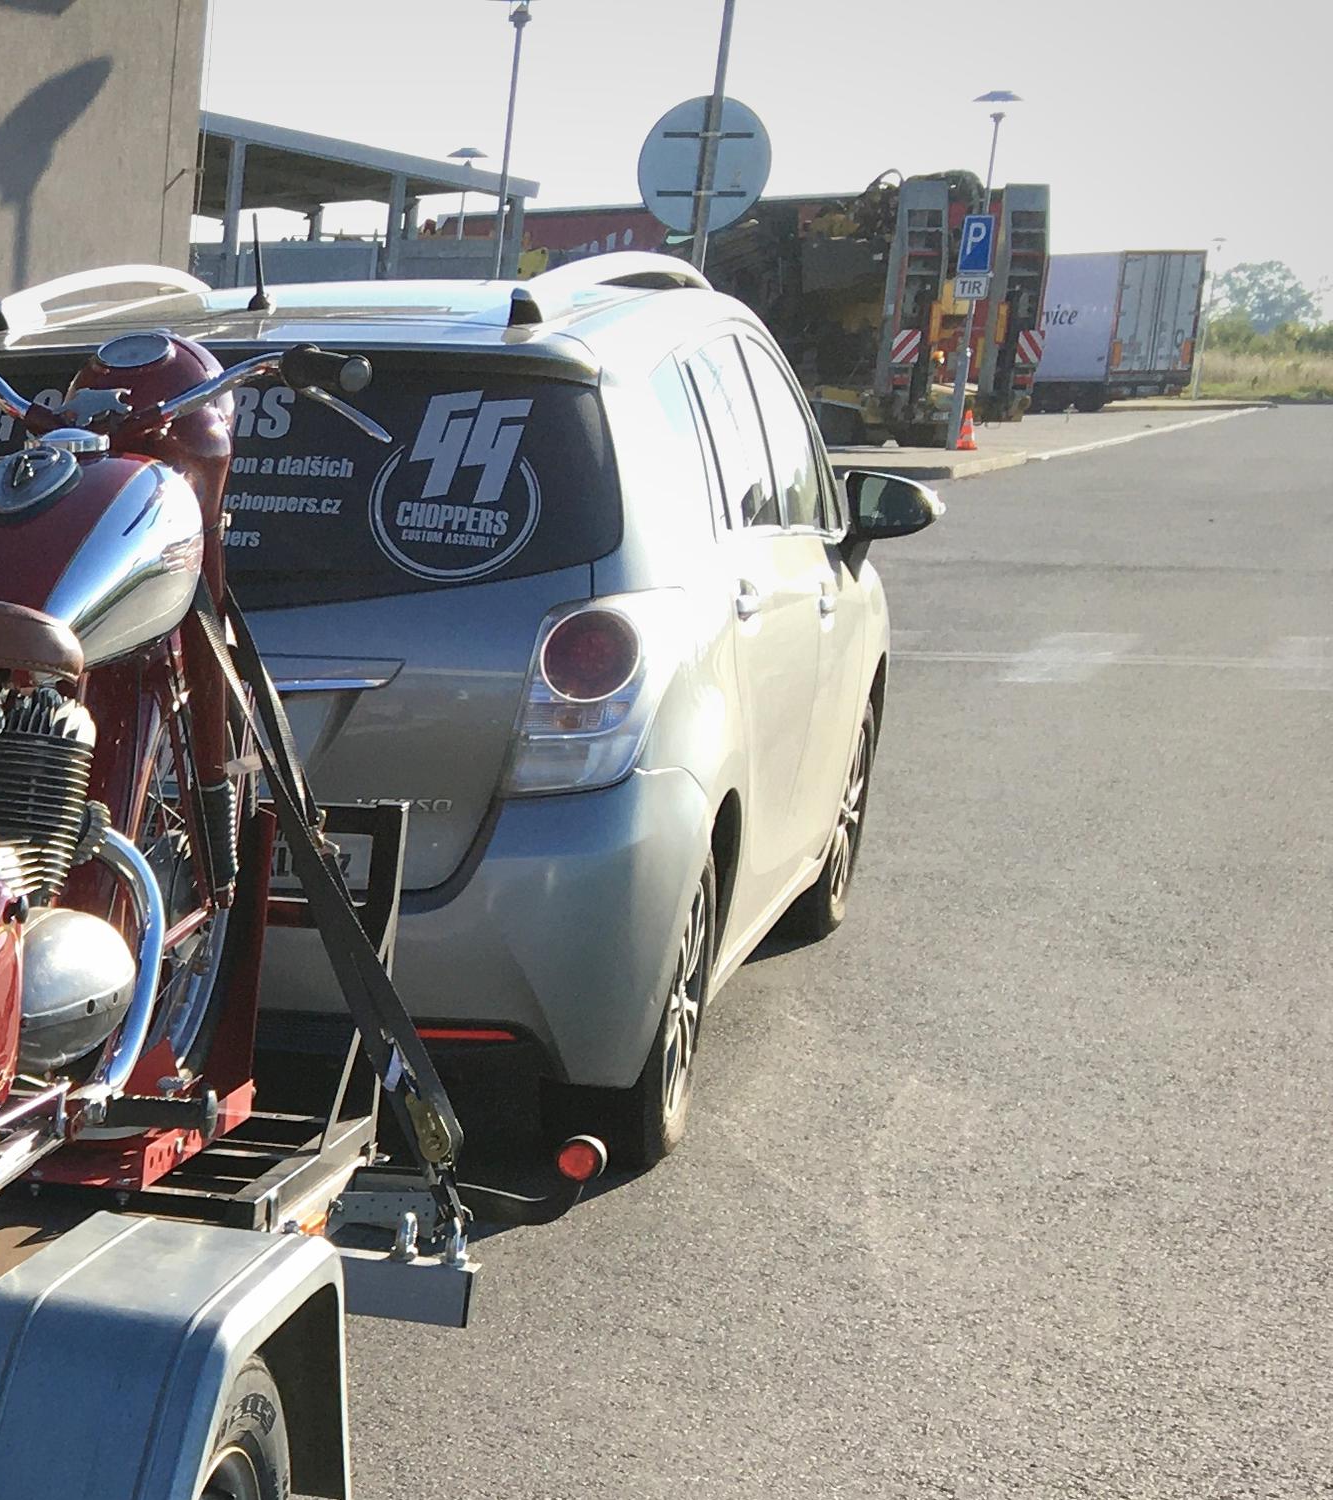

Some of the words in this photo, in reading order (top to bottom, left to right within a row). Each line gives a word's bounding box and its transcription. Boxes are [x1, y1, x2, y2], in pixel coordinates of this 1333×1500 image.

[966, 222, 986, 255] P
[959, 280, 983, 295] TIR
[1043, 304, 1078, 326] vice
[260, 458, 274, 471] a
[277, 455, 354, 479] dalších
[223, 492, 343, 515] choppers.cz
[395, 501, 509, 536] CHOPPERS
[401, 528, 442, 544] CUSTOM
[444, 532, 500, 549] ASSEMBLY
